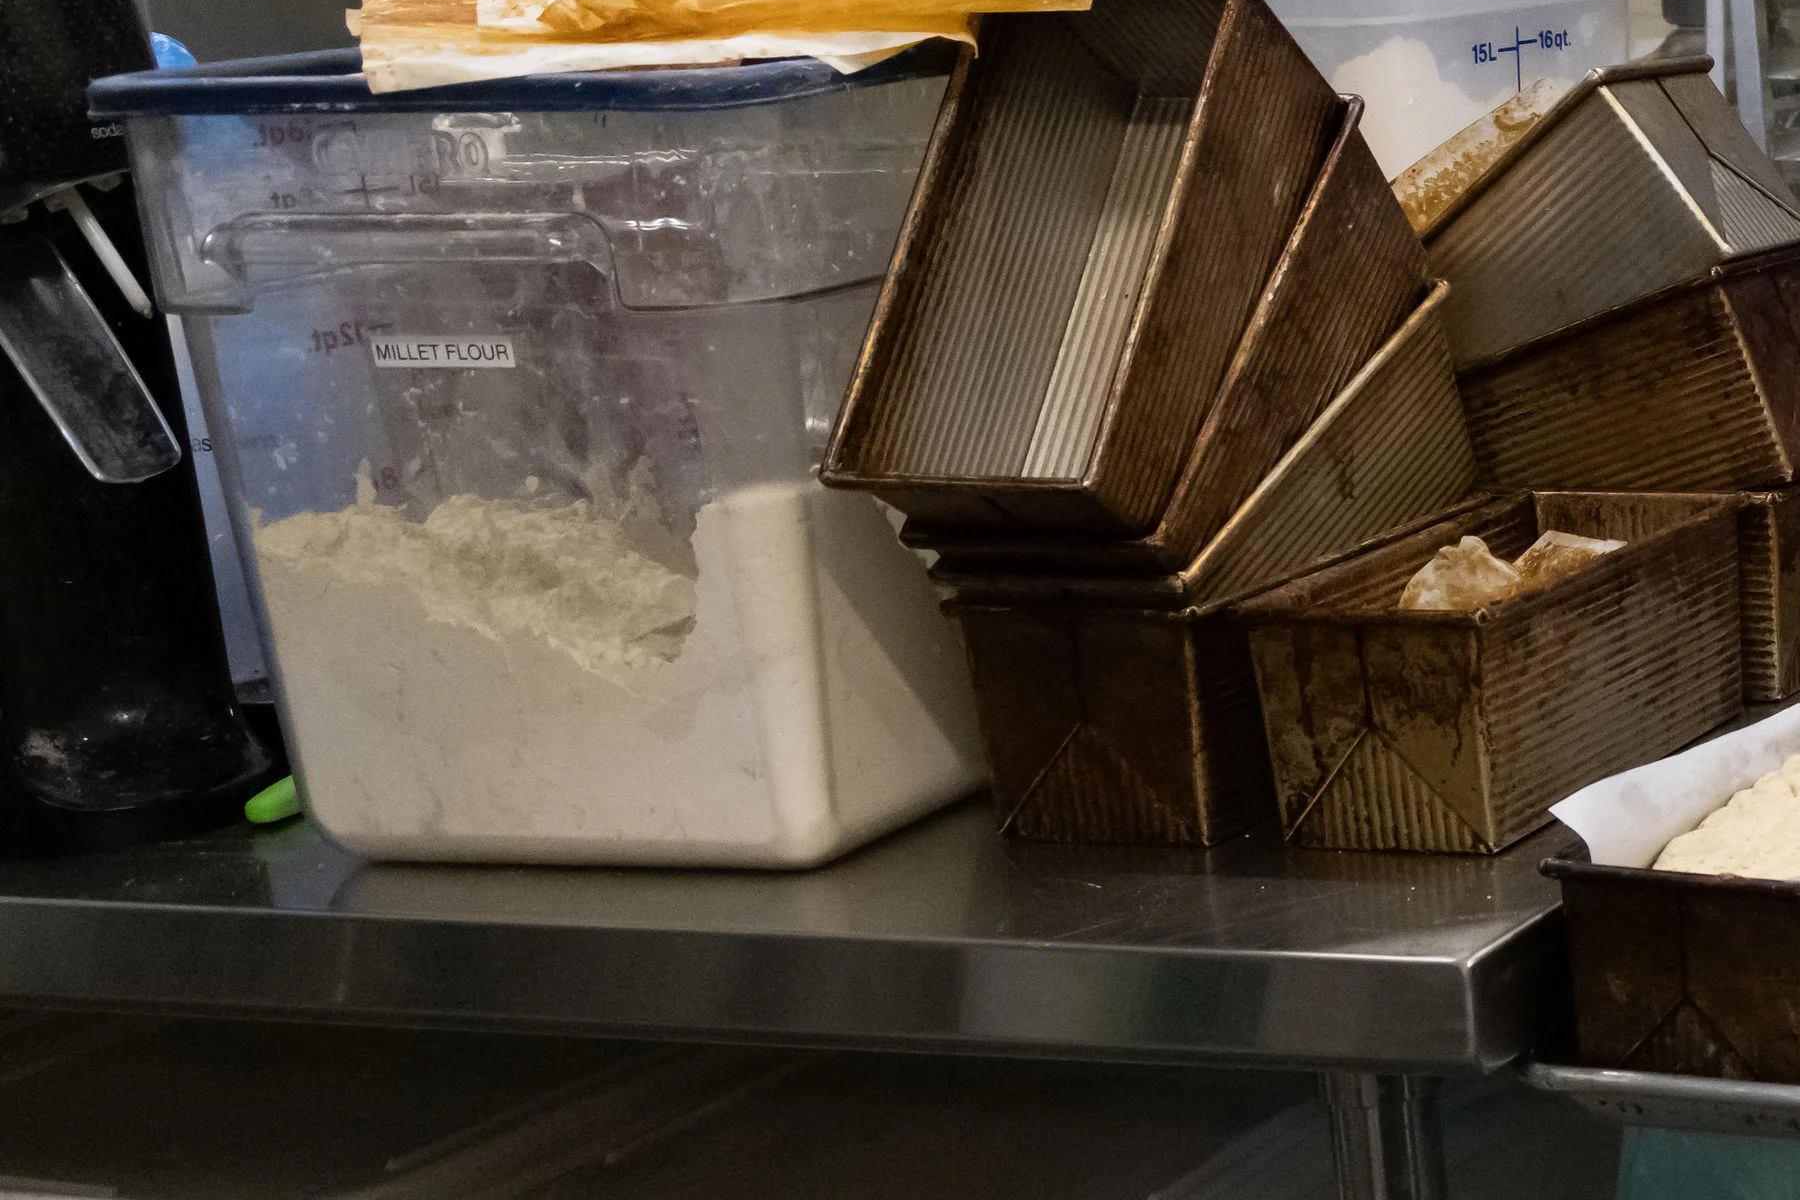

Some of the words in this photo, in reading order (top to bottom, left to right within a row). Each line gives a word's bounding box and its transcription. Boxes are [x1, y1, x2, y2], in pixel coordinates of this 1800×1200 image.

[1538, 29, 1571, 50] 16qt.
[1472, 42, 1497, 63] 15L
[375, 344, 439, 361] MILLET
[445, 344, 510, 361] FLOUR
